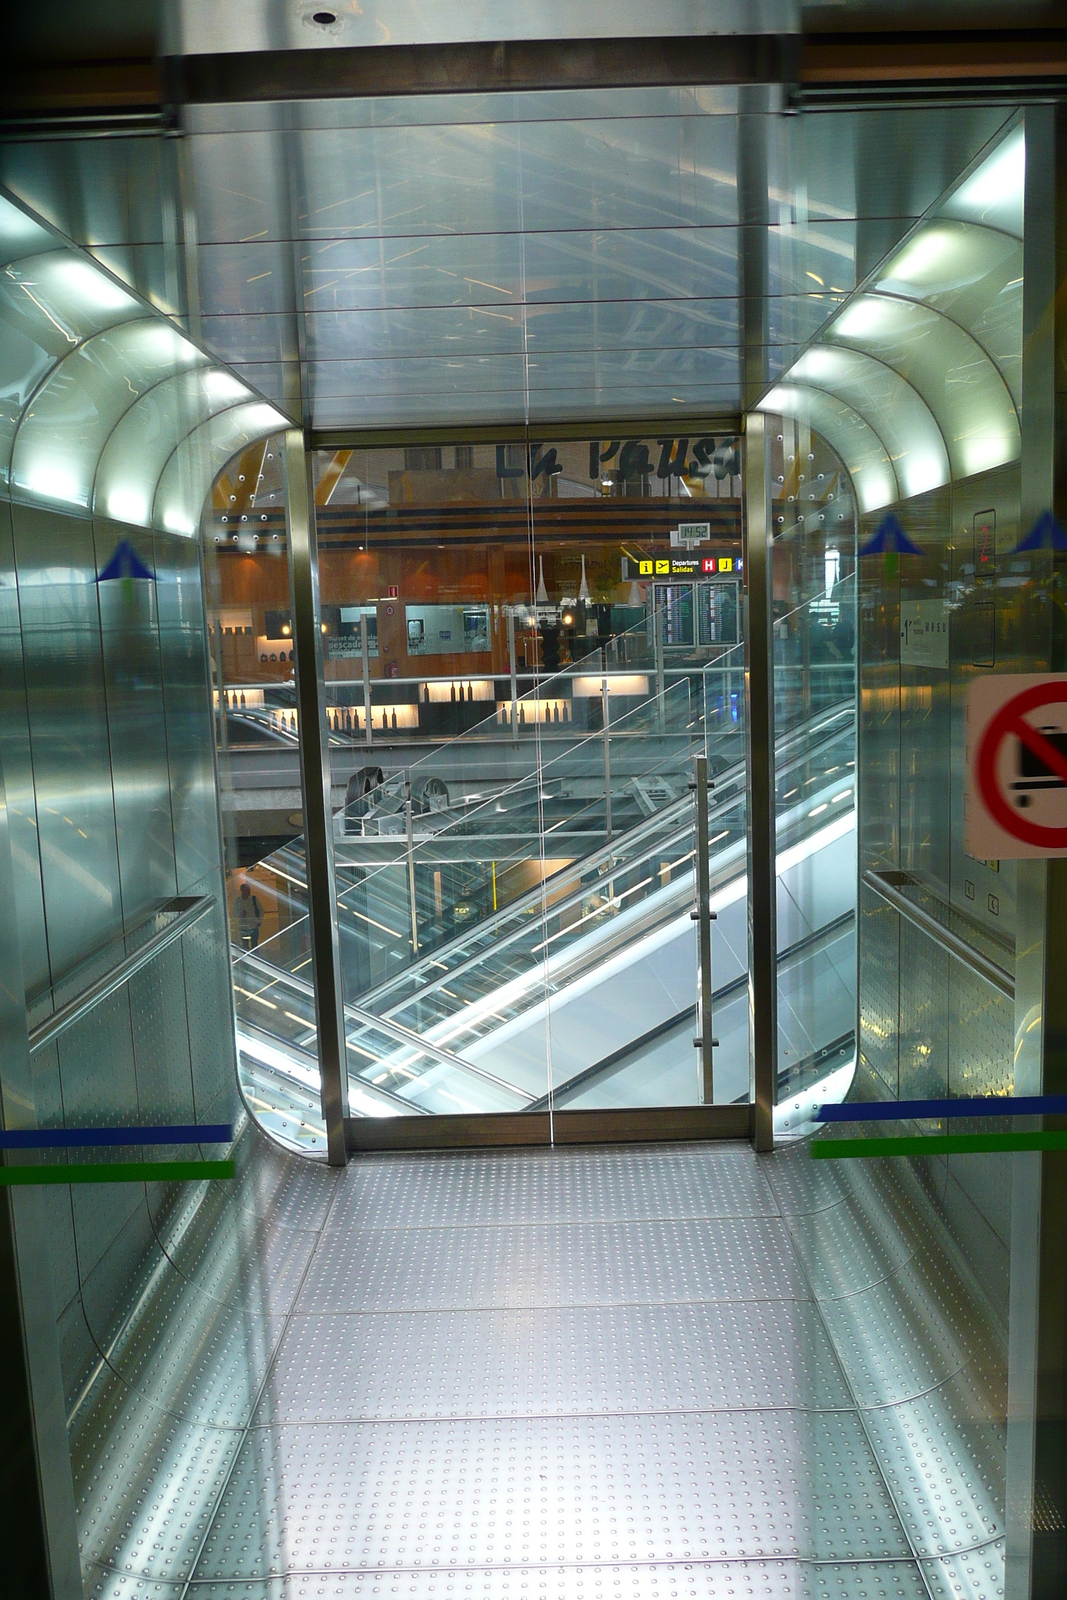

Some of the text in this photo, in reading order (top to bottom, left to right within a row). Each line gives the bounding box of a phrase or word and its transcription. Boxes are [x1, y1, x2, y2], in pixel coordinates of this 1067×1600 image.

[590, 439, 740, 480] Pausa
[705, 561, 713, 571] H
[723, 560, 728, 570] J
